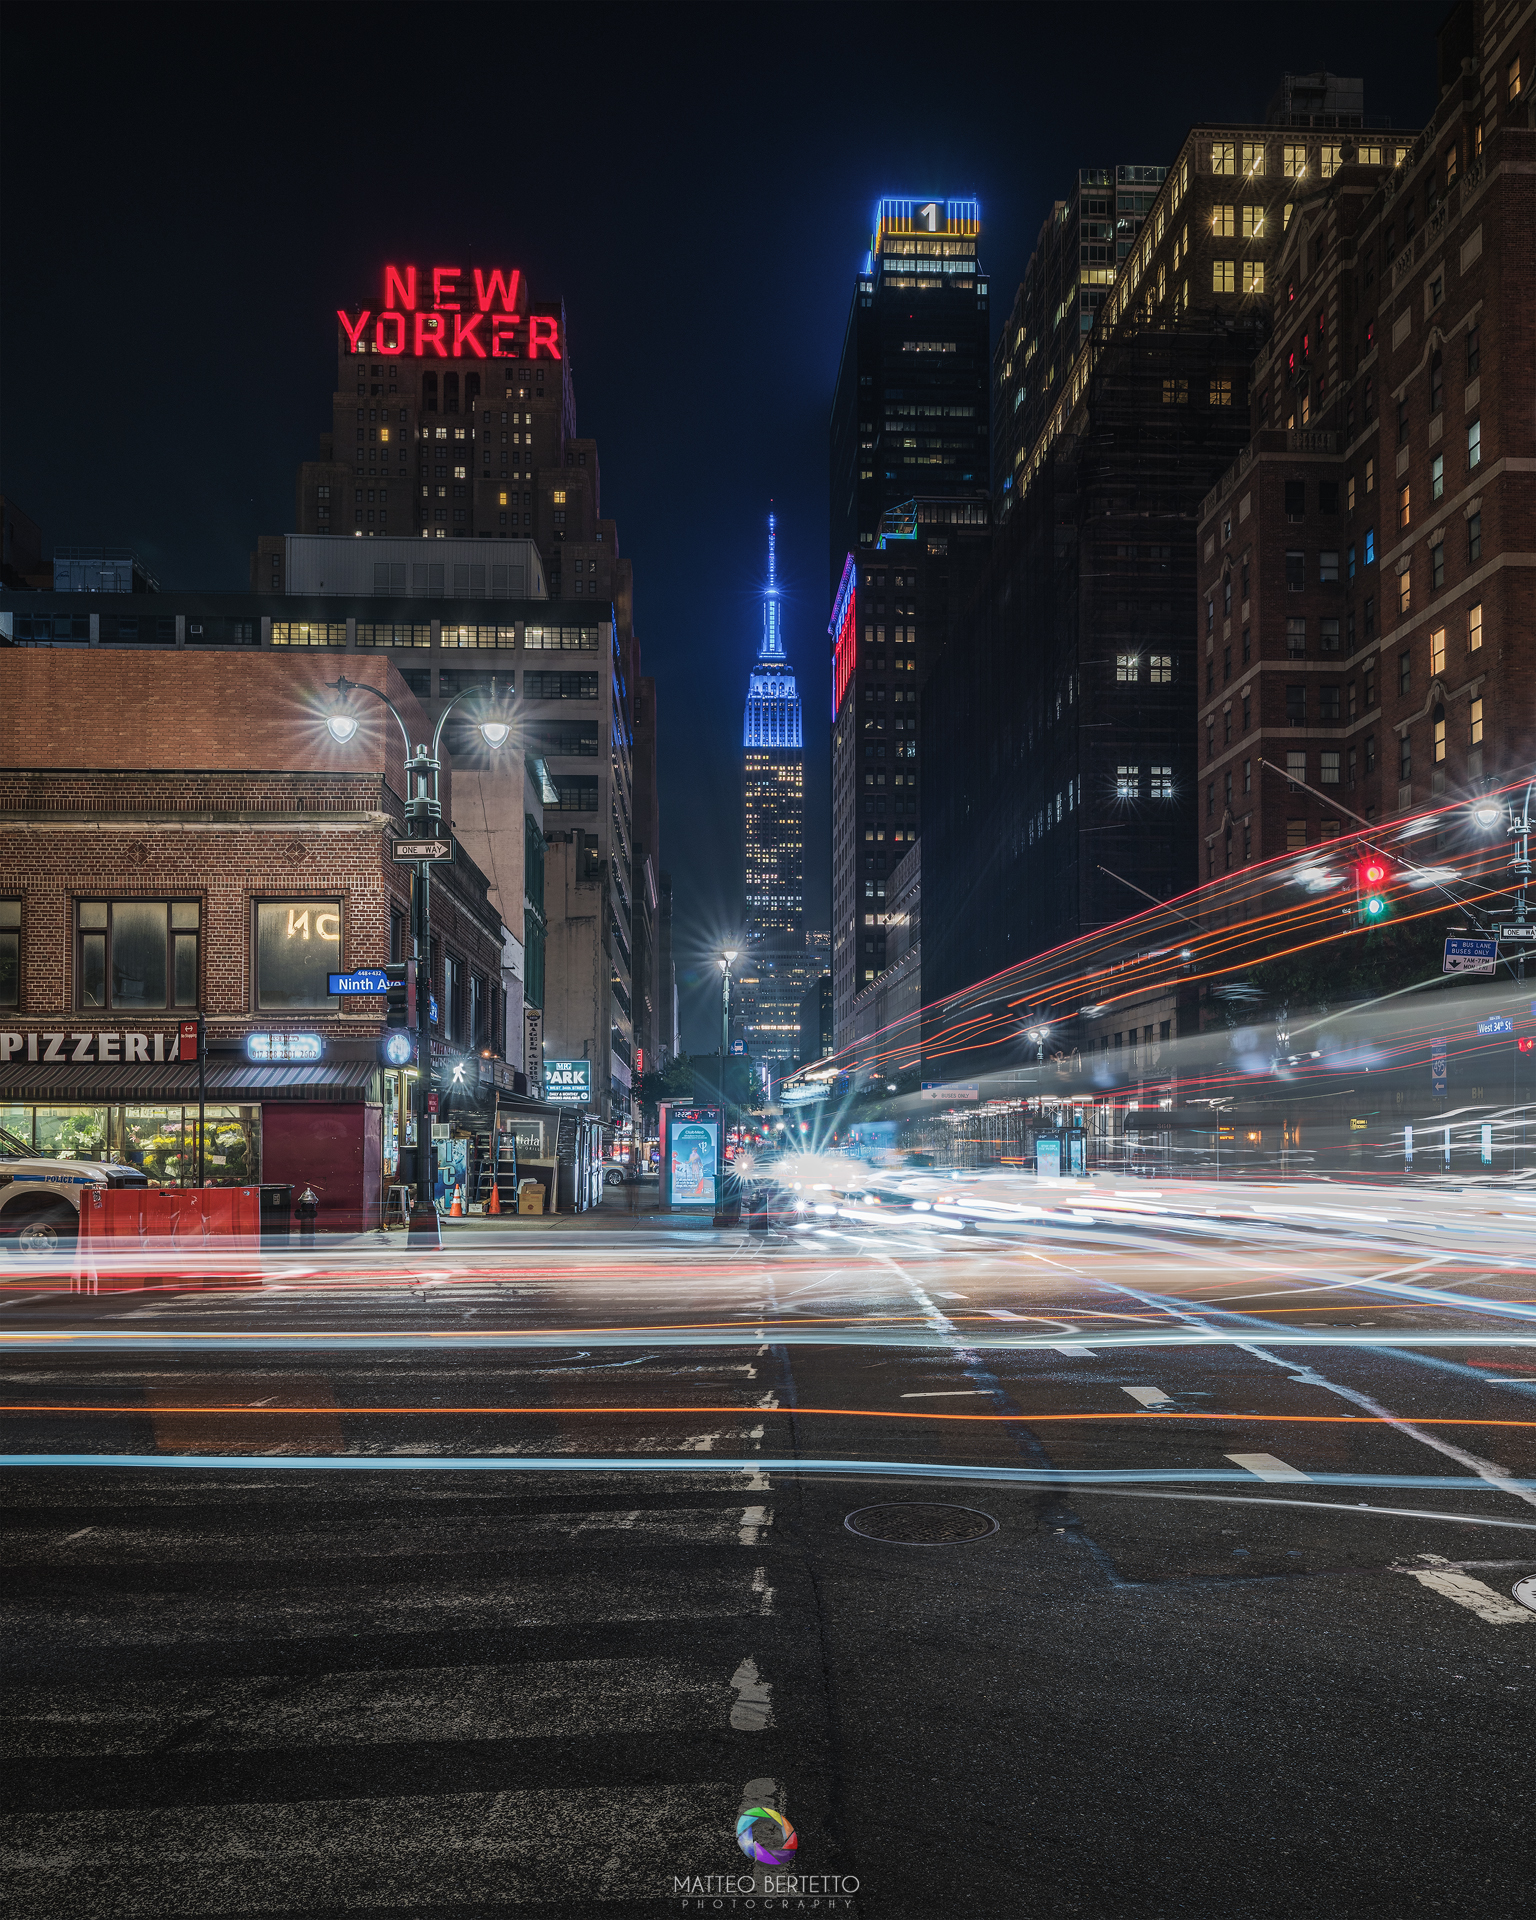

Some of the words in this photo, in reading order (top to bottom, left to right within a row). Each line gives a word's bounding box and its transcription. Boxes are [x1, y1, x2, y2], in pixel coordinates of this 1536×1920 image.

[921, 203, 936, 232] 1
[385, 265, 520, 312] NEW
[336, 310, 562, 360] YORKER
[402, 846, 418, 854] ONE
[425, 846, 442, 854] WAY
[339, 978, 374, 990] Ninth
[1478, 1023, 1494, 1034] West
[1504, 1020, 1512, 1031] St
[252, 1050, 263, 1059] 917
[300, 1050, 317, 1059] 2602
[1433, 1060, 1445, 1073] 495
[545, 1071, 585, 1084] PARK
[45, 1175, 74, 1184] POLICE
[443, 1142, 456, 1208] ICE
